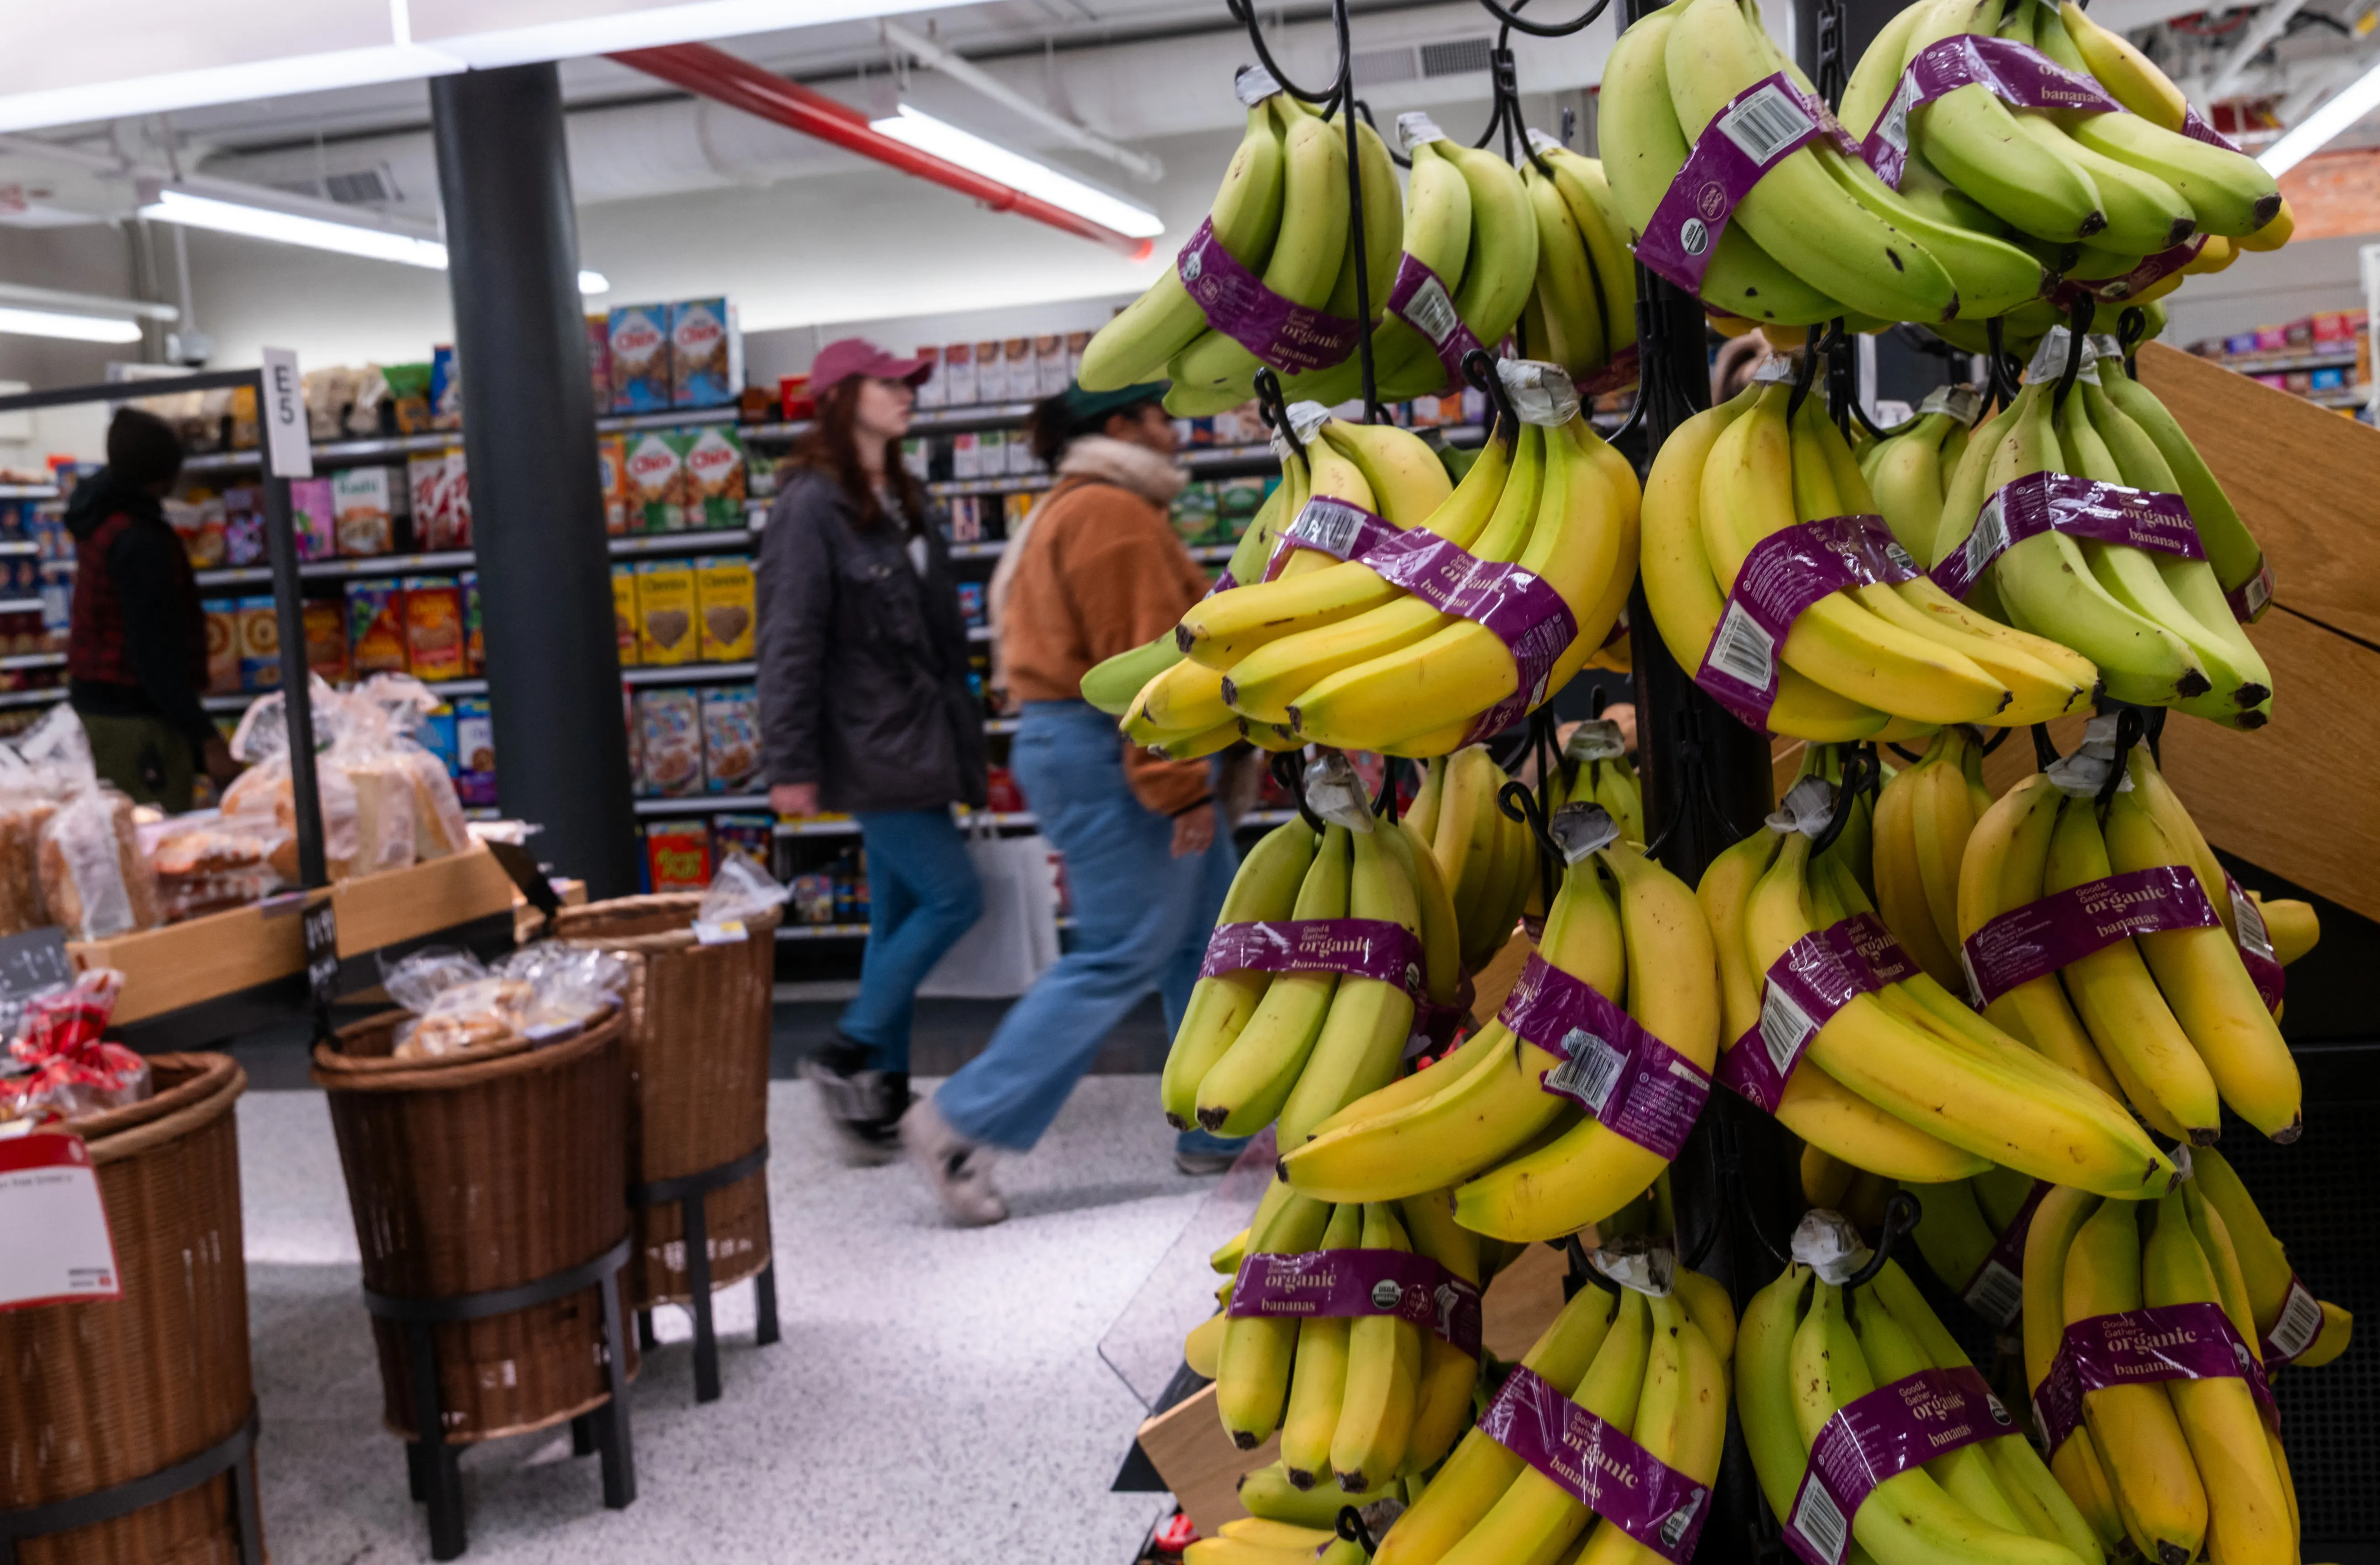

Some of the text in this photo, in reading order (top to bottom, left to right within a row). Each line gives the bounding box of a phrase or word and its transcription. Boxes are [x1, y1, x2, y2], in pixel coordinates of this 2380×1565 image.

[2041, 86, 2102, 103] bananas
[1282, 325, 1343, 349] organic
[1272, 342, 1318, 365] bananas
[2122, 507, 2193, 530] organic
[2129, 527, 2180, 550] bananas
[2076, 882, 2107, 897] Good&
[2080, 889, 2111, 904] Gather
[2085, 884, 2167, 915] organic
[1303, 925, 1329, 933] Good&
[2096, 913, 2159, 938] bananas
[1299, 936, 1373, 957] organic
[1292, 959, 1349, 970] bananas
[1265, 1270, 1336, 1294] organic
[1261, 1298, 1316, 1312] bananas
[2103, 1318, 2136, 1329] Good&
[2105, 1328, 2137, 1338] Gather
[2108, 1327, 2197, 1355] organic
[2114, 1361, 2178, 1376] banana
[1899, 1380, 1926, 1397] Good&
[1905, 1390, 1931, 1407] Gather
[1913, 1390, 1965, 1421] organic
[1927, 1423, 1971, 1448] bananas
